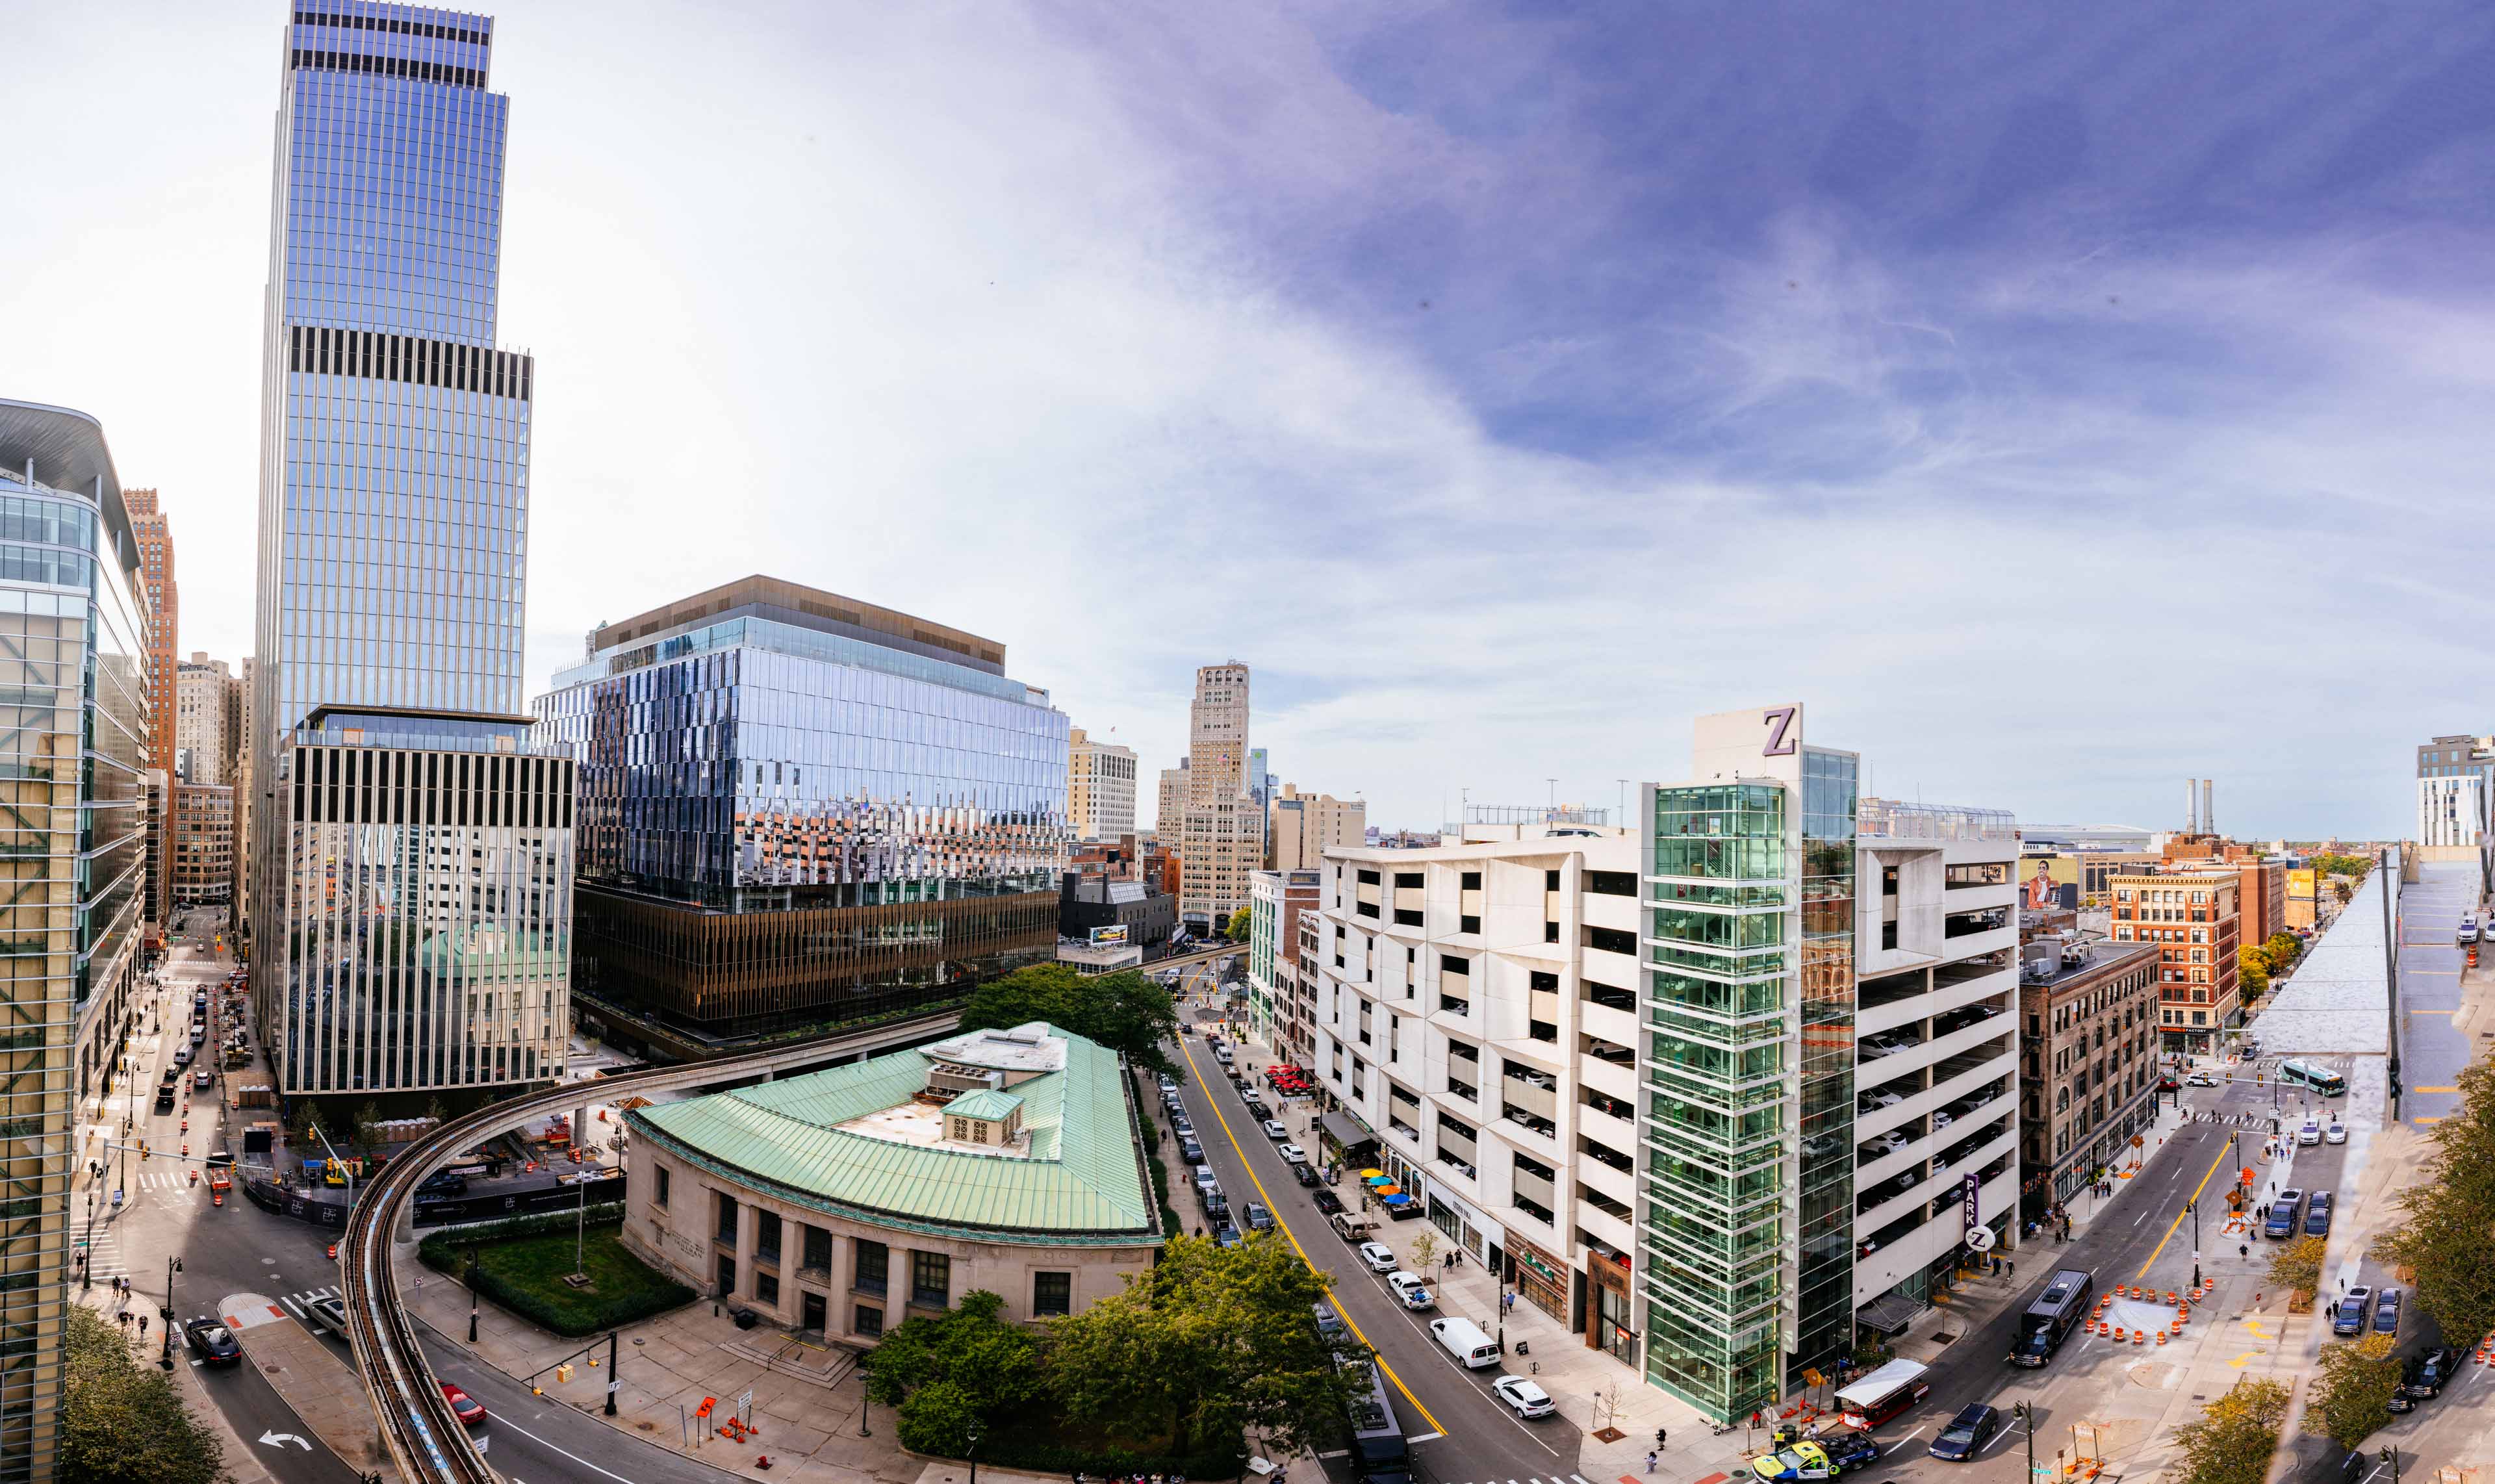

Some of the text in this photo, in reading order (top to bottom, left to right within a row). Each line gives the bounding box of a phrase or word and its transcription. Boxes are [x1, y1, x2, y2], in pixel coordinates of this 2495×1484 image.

[1762, 708, 1796, 756] Z
[758, 1195, 821, 1223] WISDOM
[836, 1220, 895, 1242] FLOWS
[1965, 1179, 1975, 1225] PARK
[1971, 1231, 1986, 1248] Z
